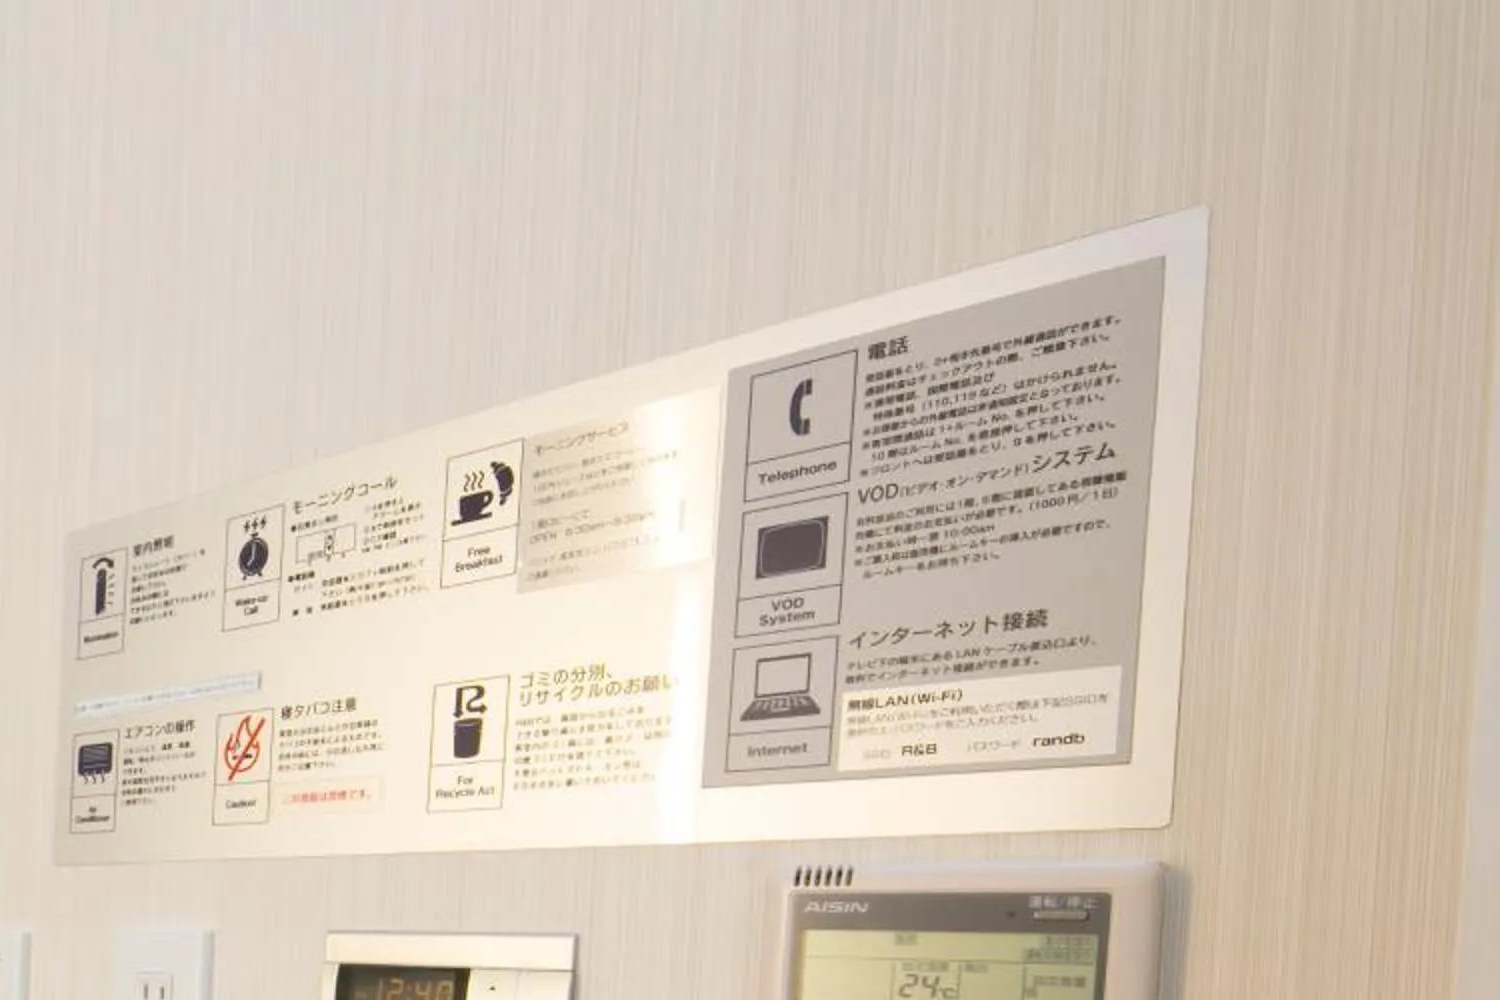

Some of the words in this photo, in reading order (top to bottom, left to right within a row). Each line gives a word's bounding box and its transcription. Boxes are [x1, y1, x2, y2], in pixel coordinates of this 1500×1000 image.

[867, 335, 909, 360] 電話
[758, 461, 838, 485] Telephone
[293, 475, 397, 516] モーニングコール
[467, 546, 491, 559] Free
[454, 554, 503, 573] Breakfast
[771, 598, 805, 612] VOD
[759, 610, 816, 627] System
[849, 608, 1049, 649] インターネット接続
[519, 663, 613, 690] ゴミの分別、
[281, 697, 357, 720] 寝タバコ注意
[124, 719, 196, 740] エアコンの操作
[747, 742, 809, 759] Internet
[901, 743, 938, 757] R&B
[1032, 733, 1086, 748] randb
[457, 774, 474, 786] For
[803, 900, 869, 914] AISIN
